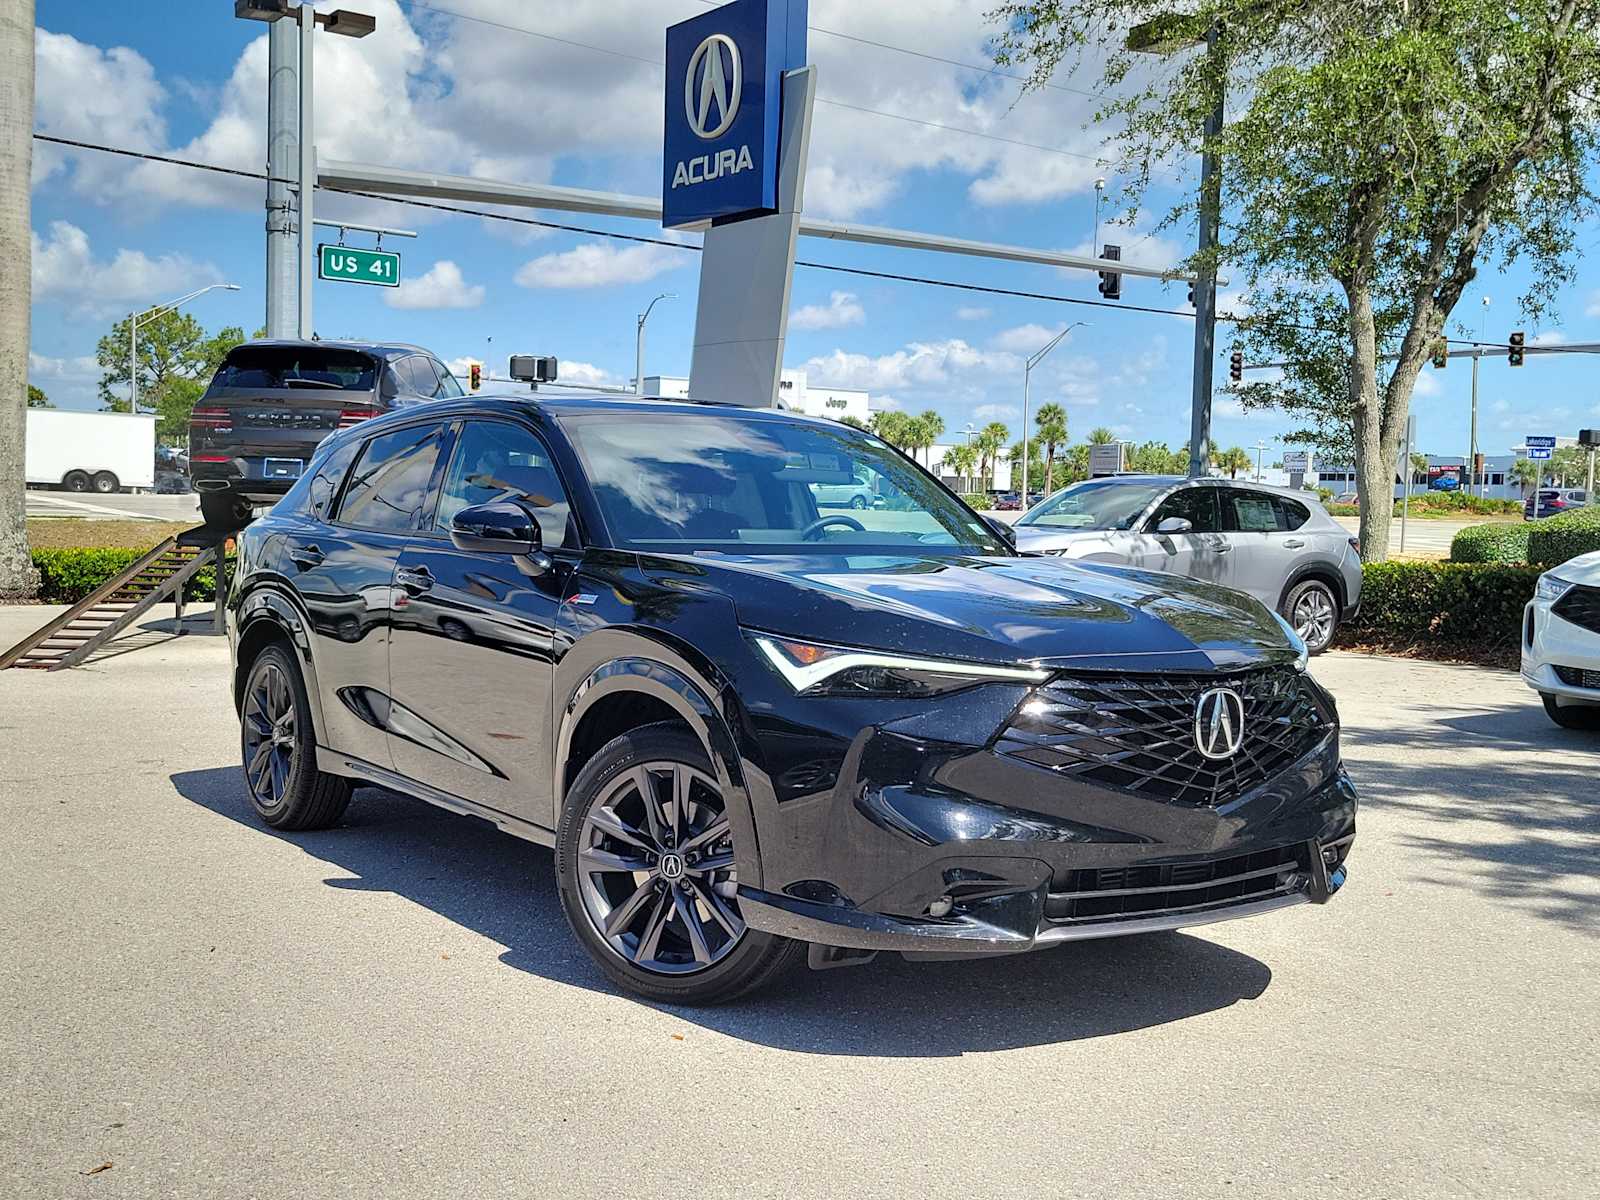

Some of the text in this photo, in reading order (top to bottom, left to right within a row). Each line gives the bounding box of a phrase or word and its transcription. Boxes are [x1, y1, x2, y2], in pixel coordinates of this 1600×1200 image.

[672, 145, 754, 189] ACURA
[331, 254, 391, 277] US 41
[825, 396, 848, 409] Jeep
